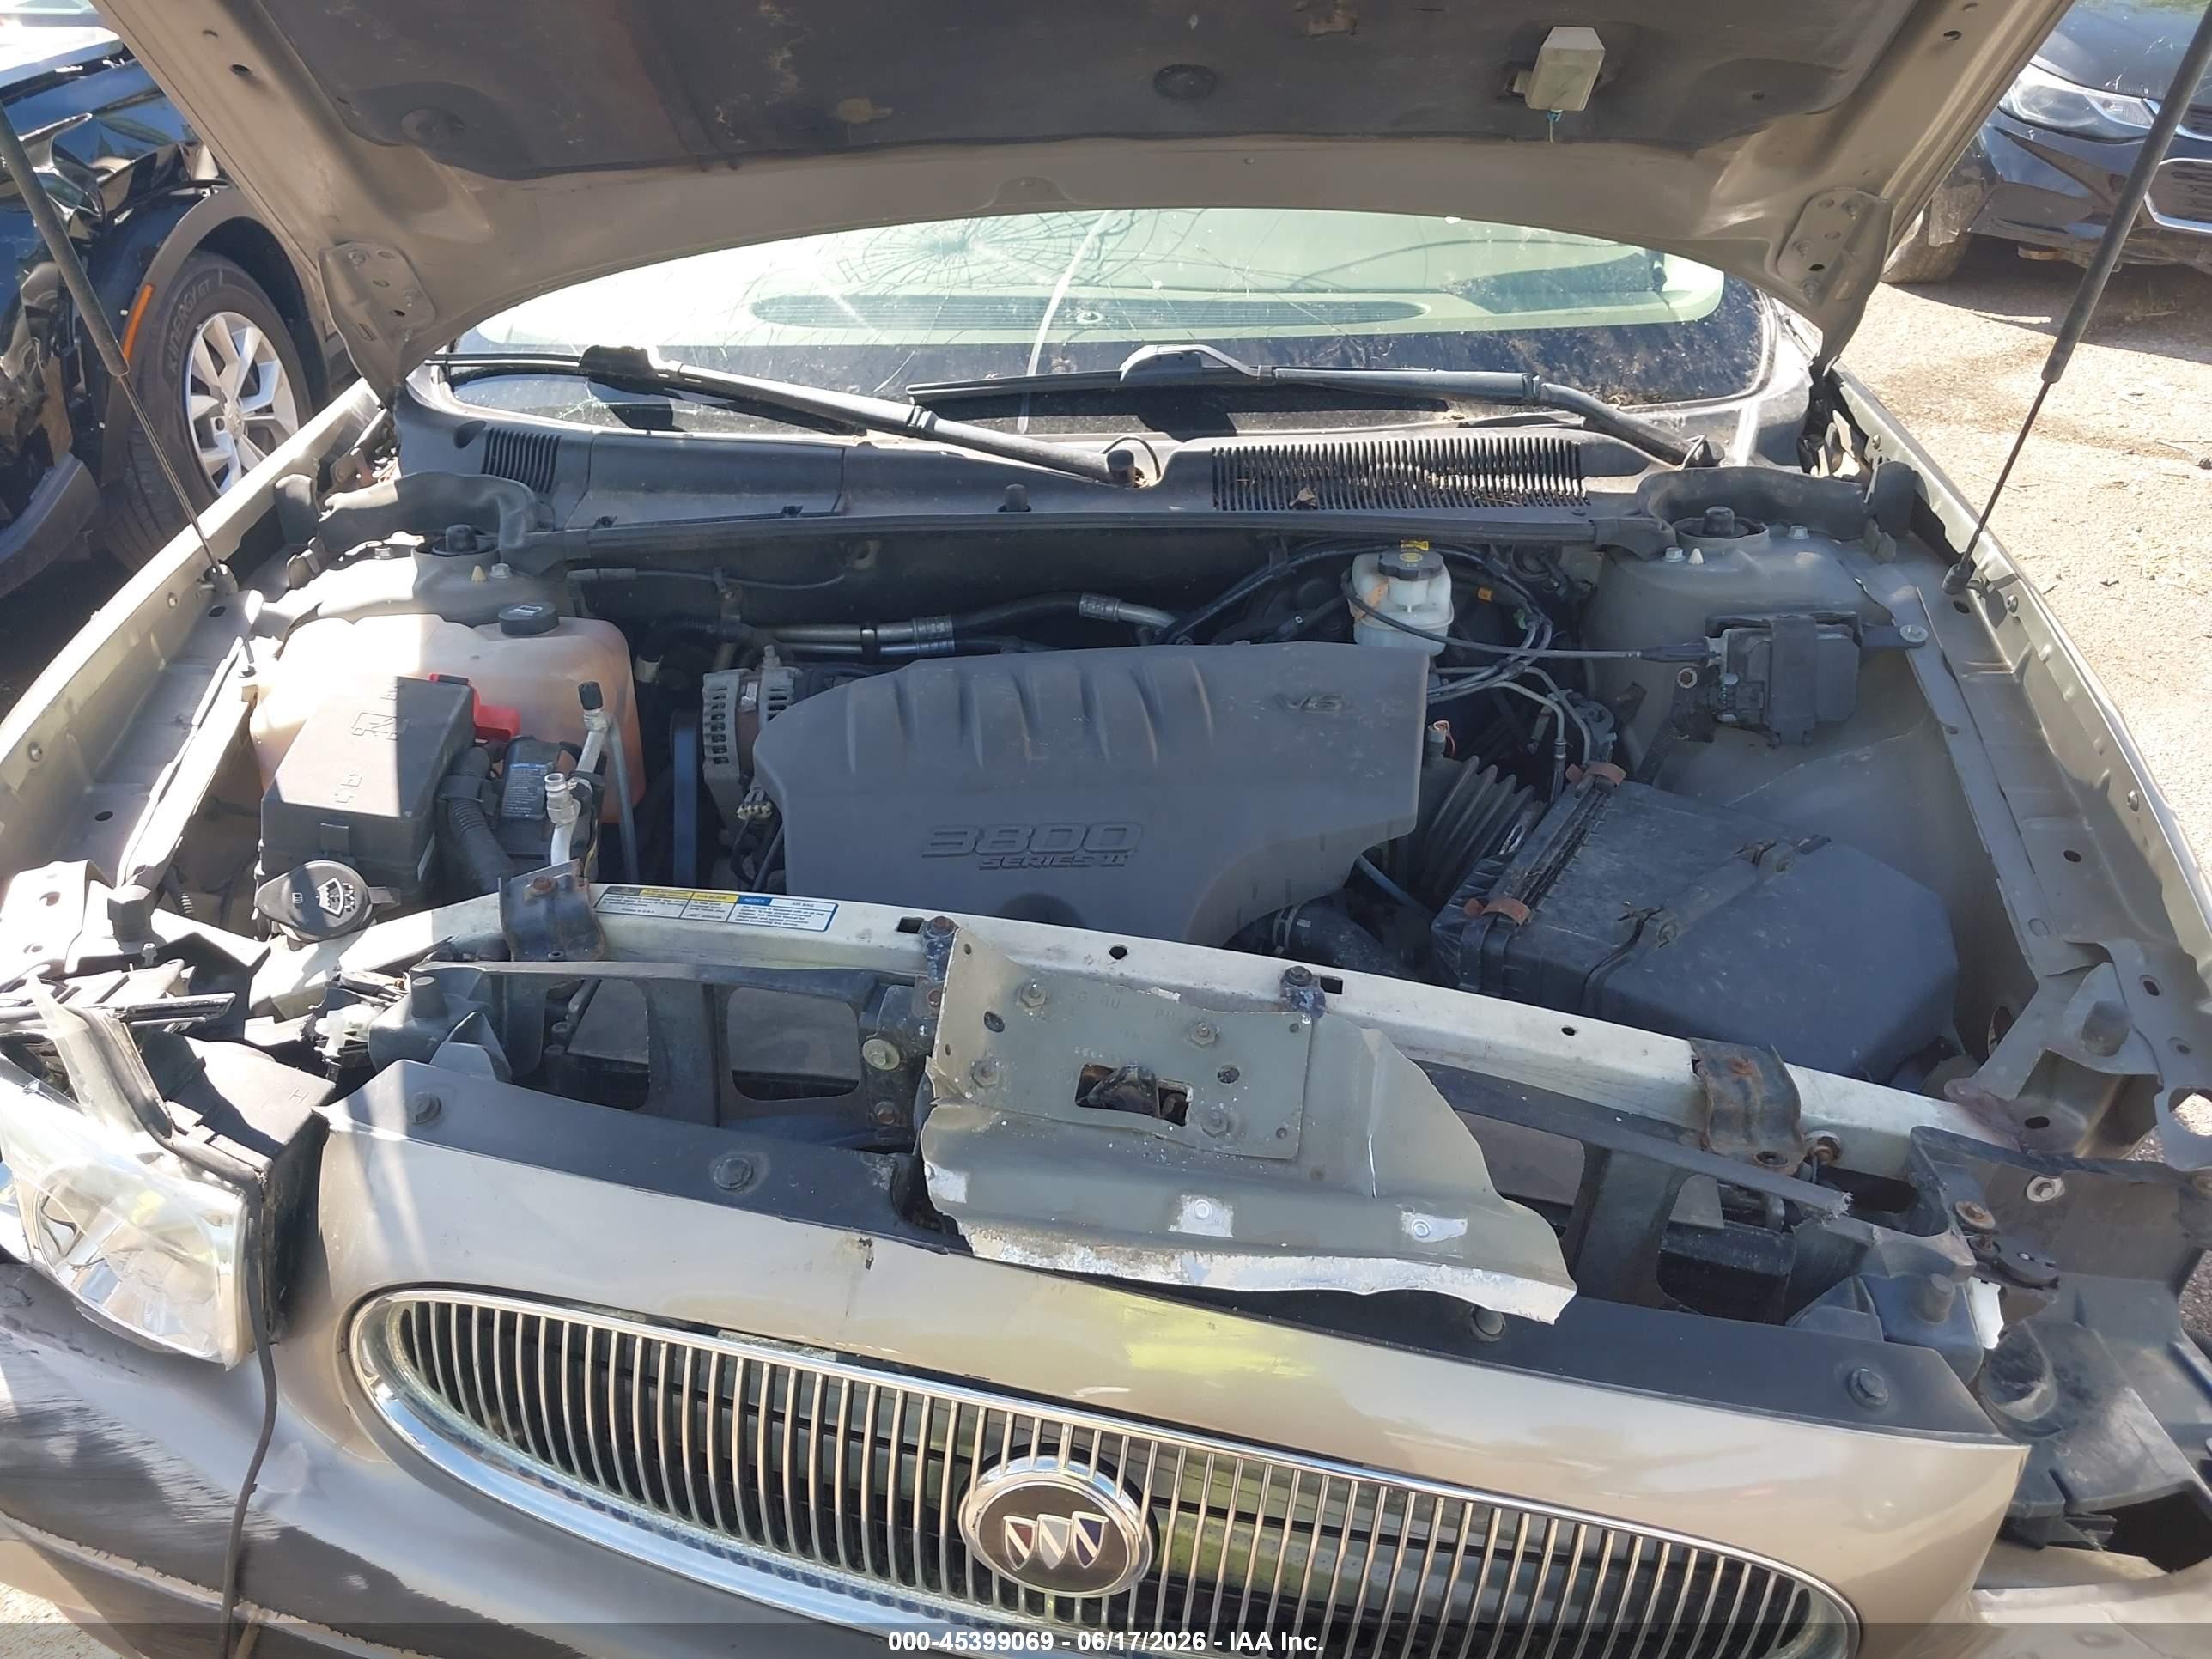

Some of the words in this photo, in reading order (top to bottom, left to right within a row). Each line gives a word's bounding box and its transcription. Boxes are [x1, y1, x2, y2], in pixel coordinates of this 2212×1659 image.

[167, 284, 198, 376] KINERGY
[921, 822, 1144, 859] 3800
[979, 856, 1094, 871] SERIES
